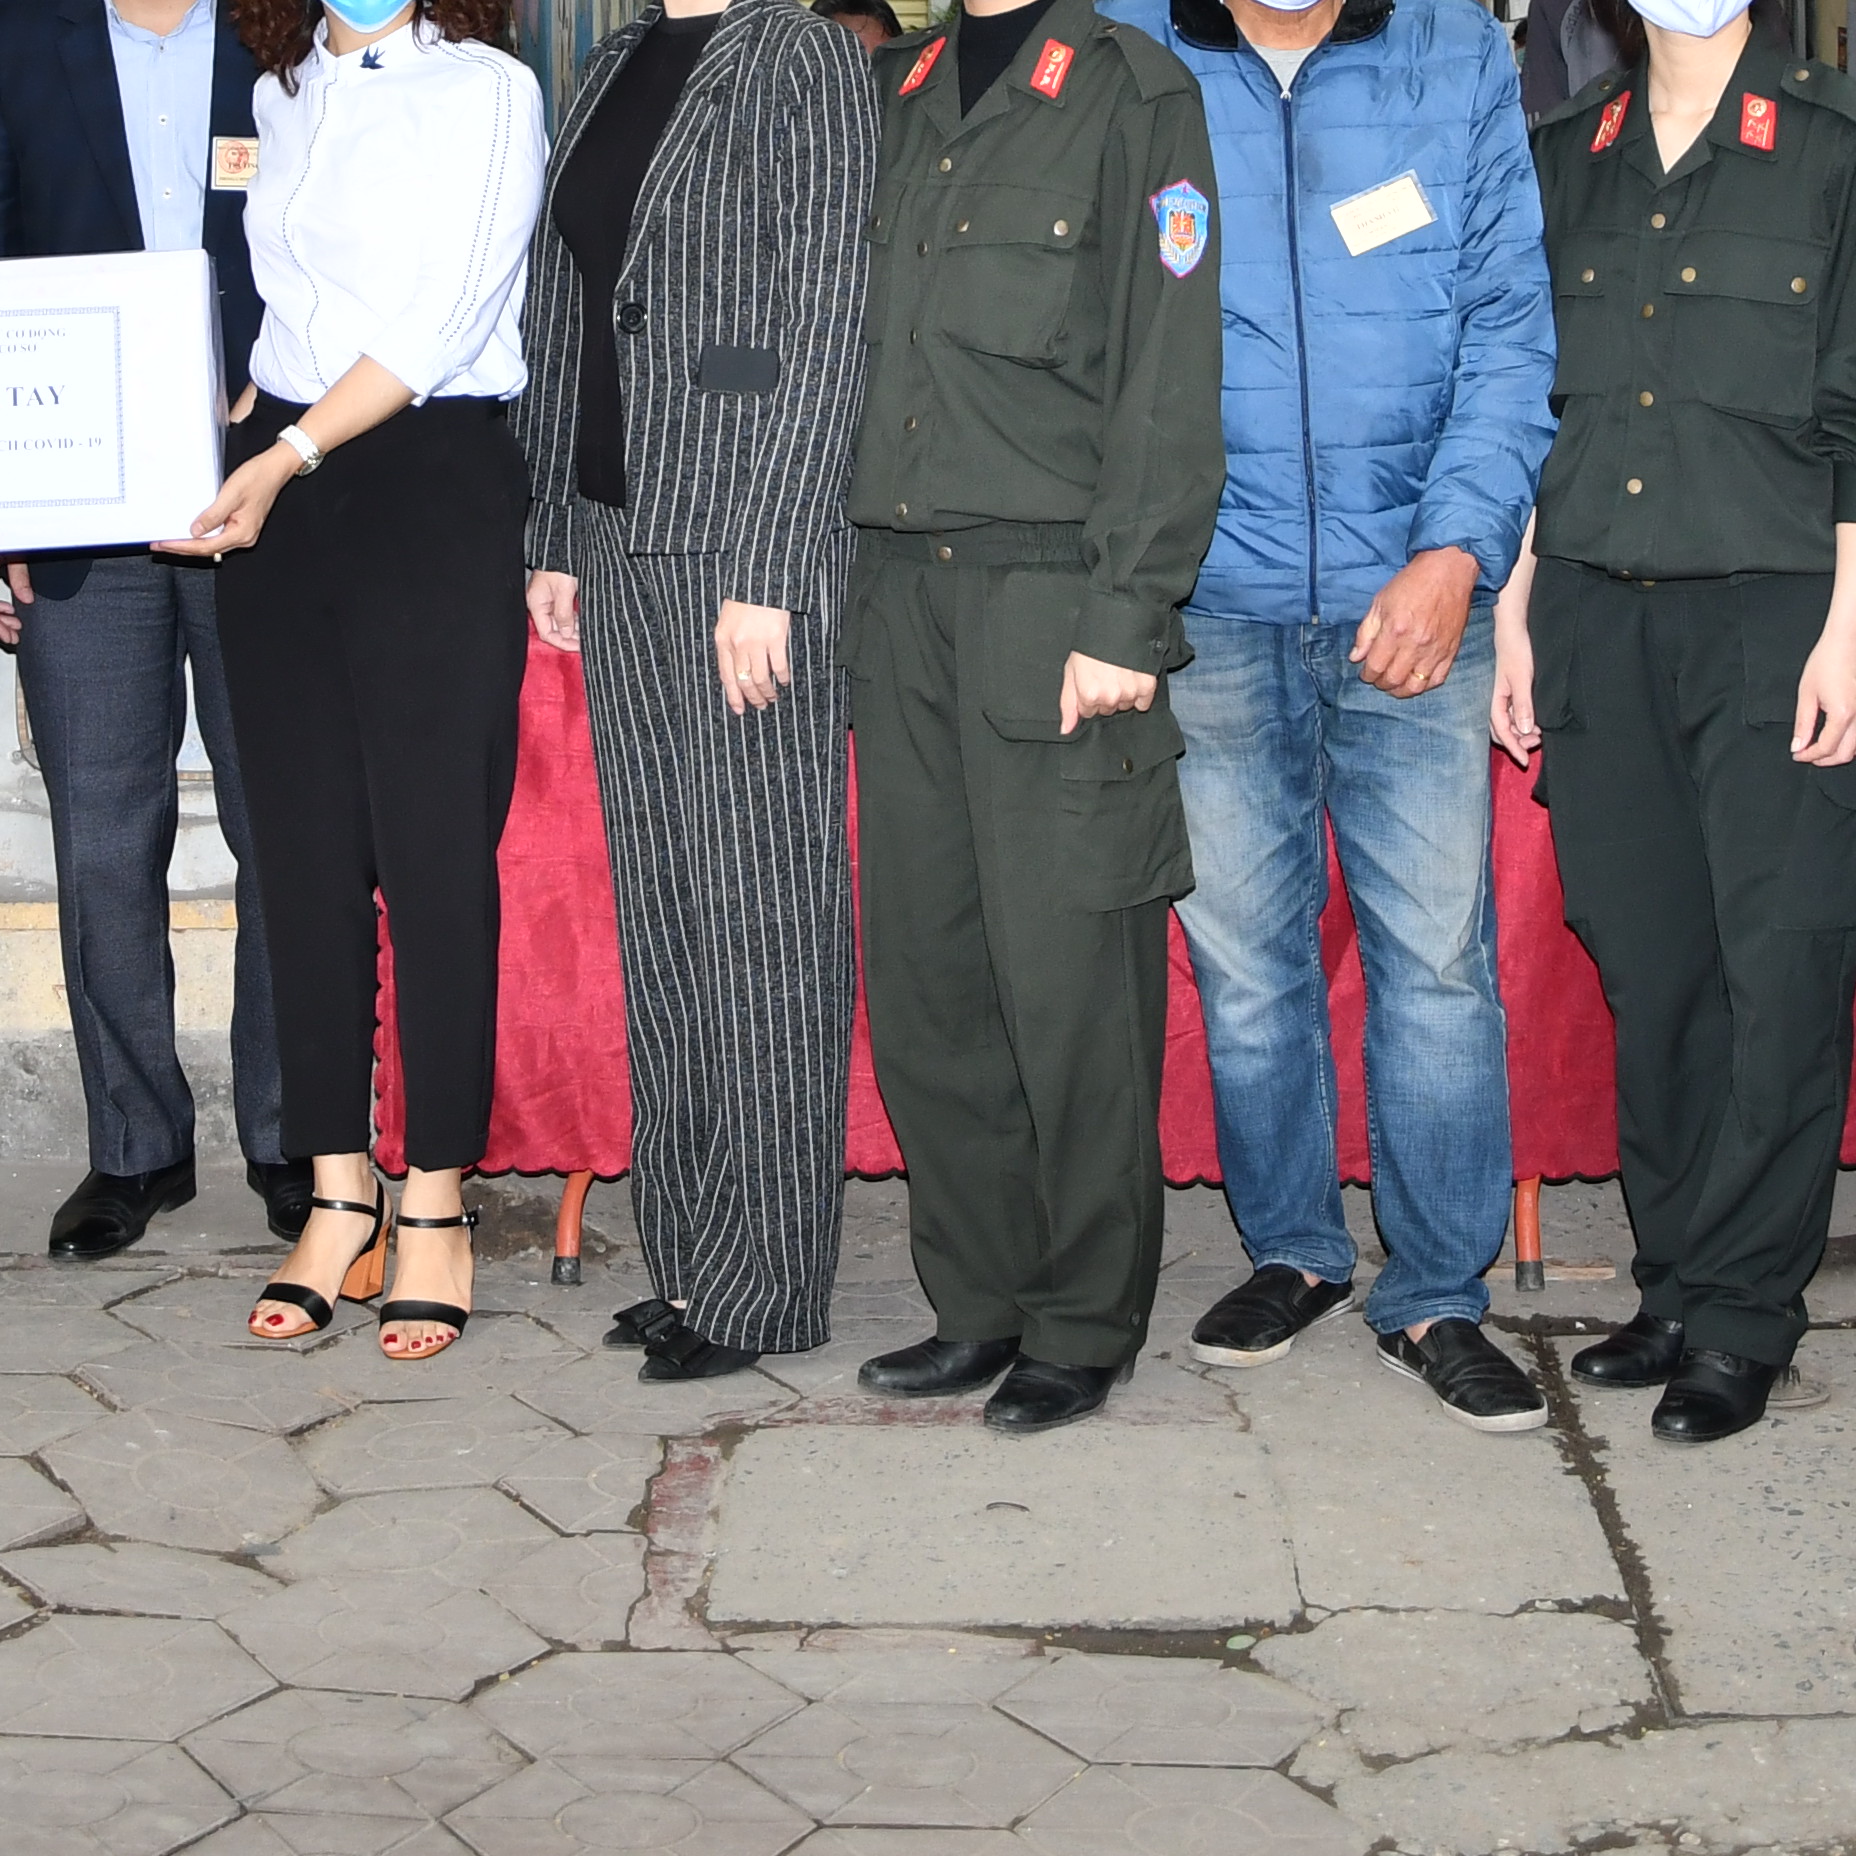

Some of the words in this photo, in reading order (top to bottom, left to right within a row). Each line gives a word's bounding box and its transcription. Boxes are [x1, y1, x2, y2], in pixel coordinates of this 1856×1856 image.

[6, 385, 65, 407] TAY
[23, 438, 74, 451] COVID
[88, 437, 101, 448] 19
